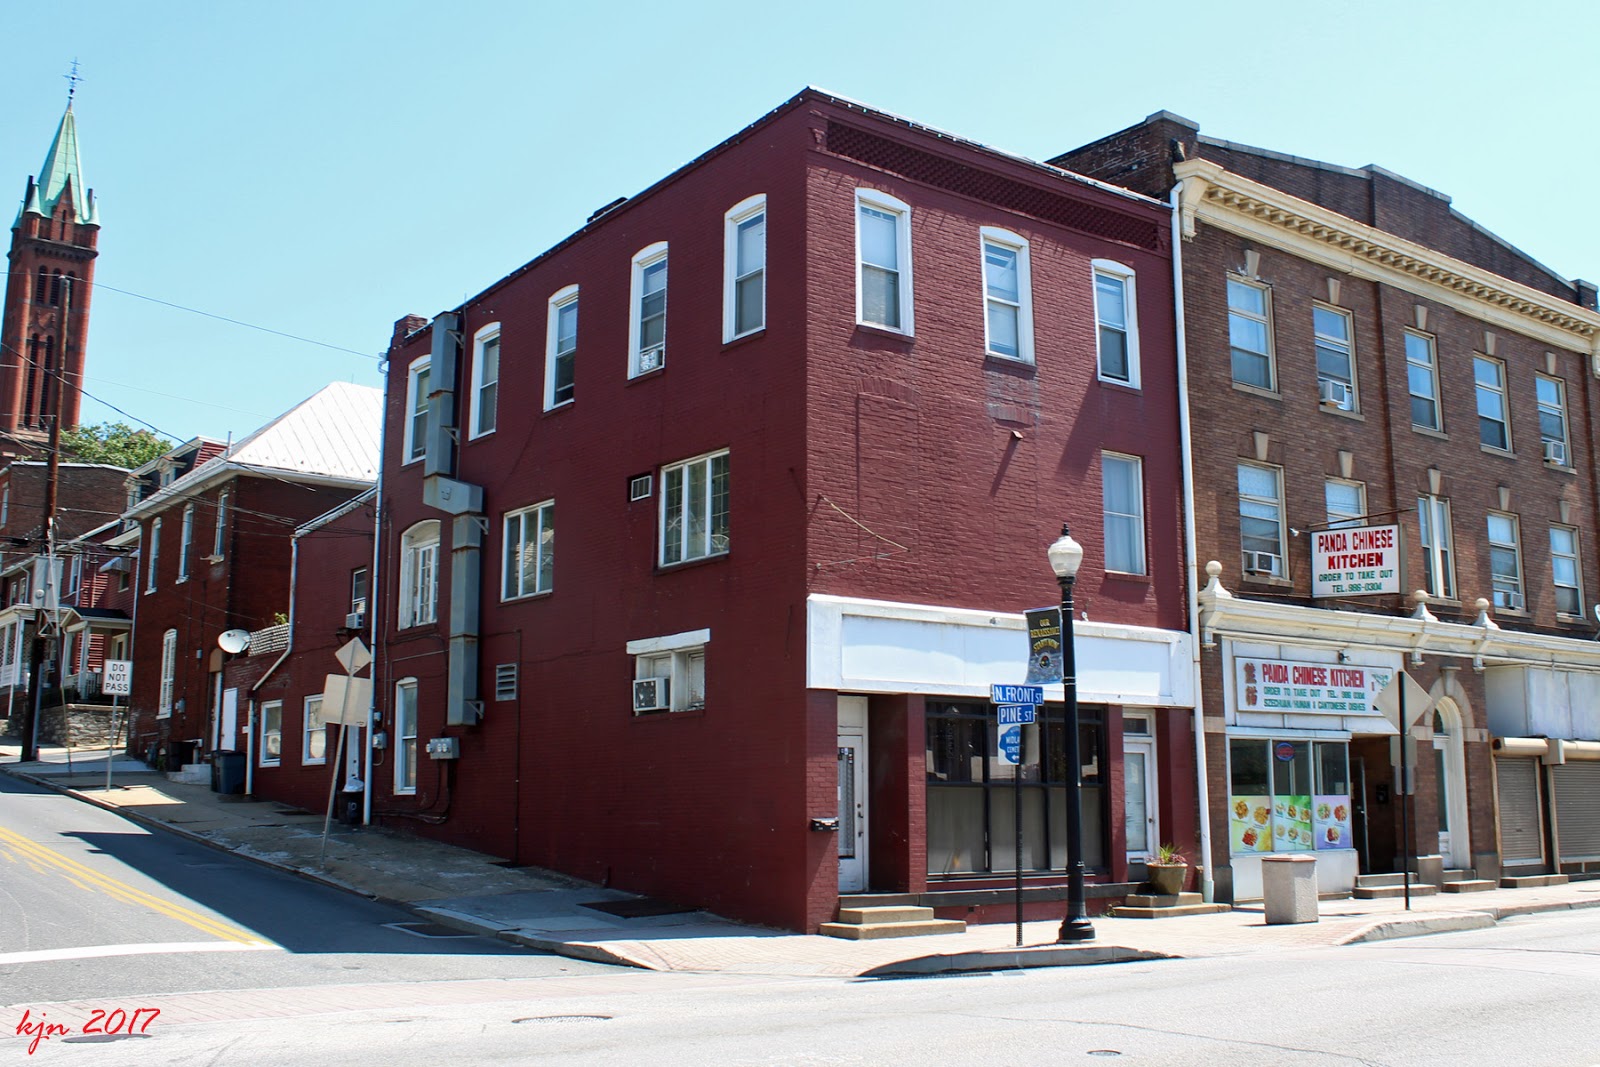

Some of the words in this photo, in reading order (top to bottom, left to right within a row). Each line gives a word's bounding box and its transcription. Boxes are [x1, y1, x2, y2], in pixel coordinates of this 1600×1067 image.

[1319, 533, 1347, 553] PANDA
[1353, 529, 1393, 550] CHINESE
[1328, 552, 1383, 570] KITCHEN
[1319, 573, 1342, 582] ORDER
[1345, 572, 1354, 580] TO
[1358, 571, 1375, 580] TAKE
[1380, 570, 1393, 578] OUT
[112, 663, 125, 672] DO
[108, 673, 126, 682] NOT
[1262, 663, 1289, 684] PANDA
[1293, 666, 1327, 686] CHINESE
[1330, 669, 1365, 688] KITCHEN
[105, 683, 128, 692] PASS
[1264, 686, 1281, 695] ORDER
[1283, 688, 1291, 696] TO
[1293, 688, 1307, 697] TAKE
[1310, 689, 1320, 697] OUT
[1035, 692, 1042, 703] ST
[1000, 707, 1022, 723] PINE
[1024, 711, 1032, 721] ST
